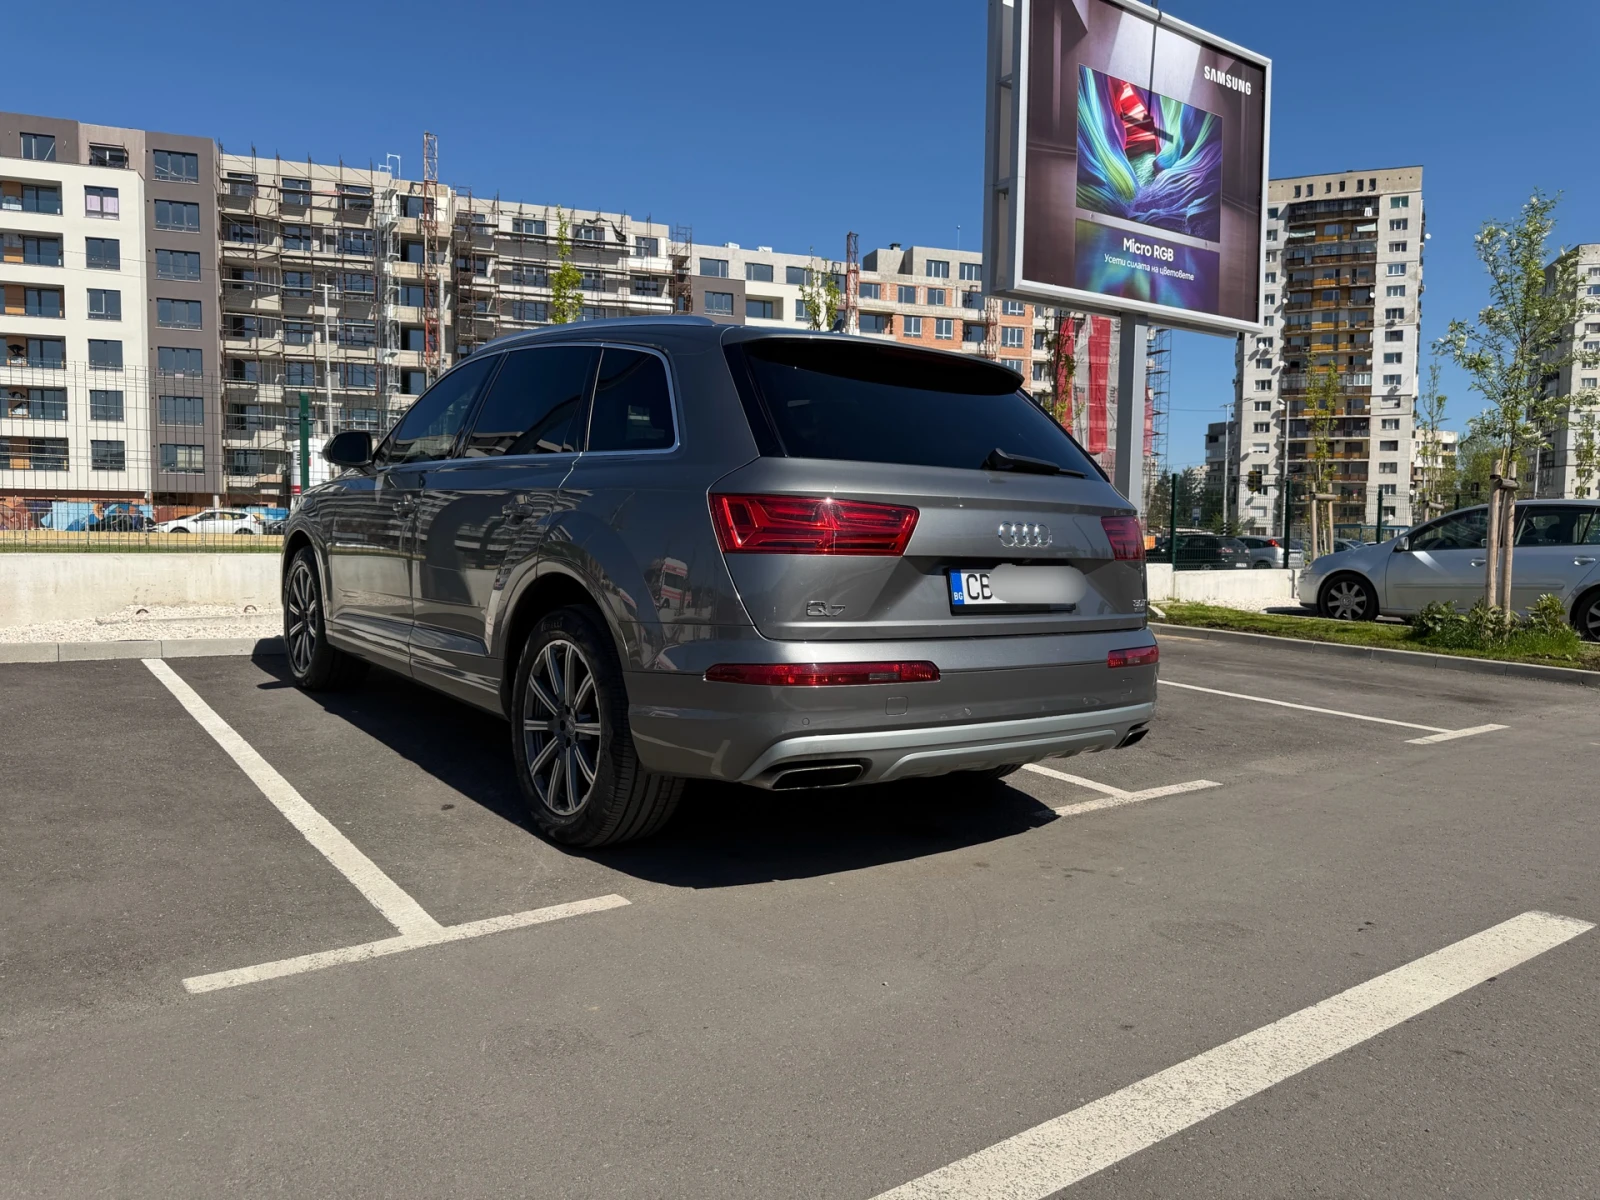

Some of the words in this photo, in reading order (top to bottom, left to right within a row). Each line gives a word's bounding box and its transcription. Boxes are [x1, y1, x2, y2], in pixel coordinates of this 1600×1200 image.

[1203, 65, 1252, 95] SAMSUNG
[1123, 237, 1152, 257] Micro
[1153, 244, 1174, 262] RGB
[1104, 253, 1126, 267] Усети
[1126, 260, 1151, 272] силата
[1151, 265, 1159, 274] на
[1159, 266, 1195, 281] цветовете
[806, 600, 846, 617] Q7
[953, 591, 964, 601] BG
